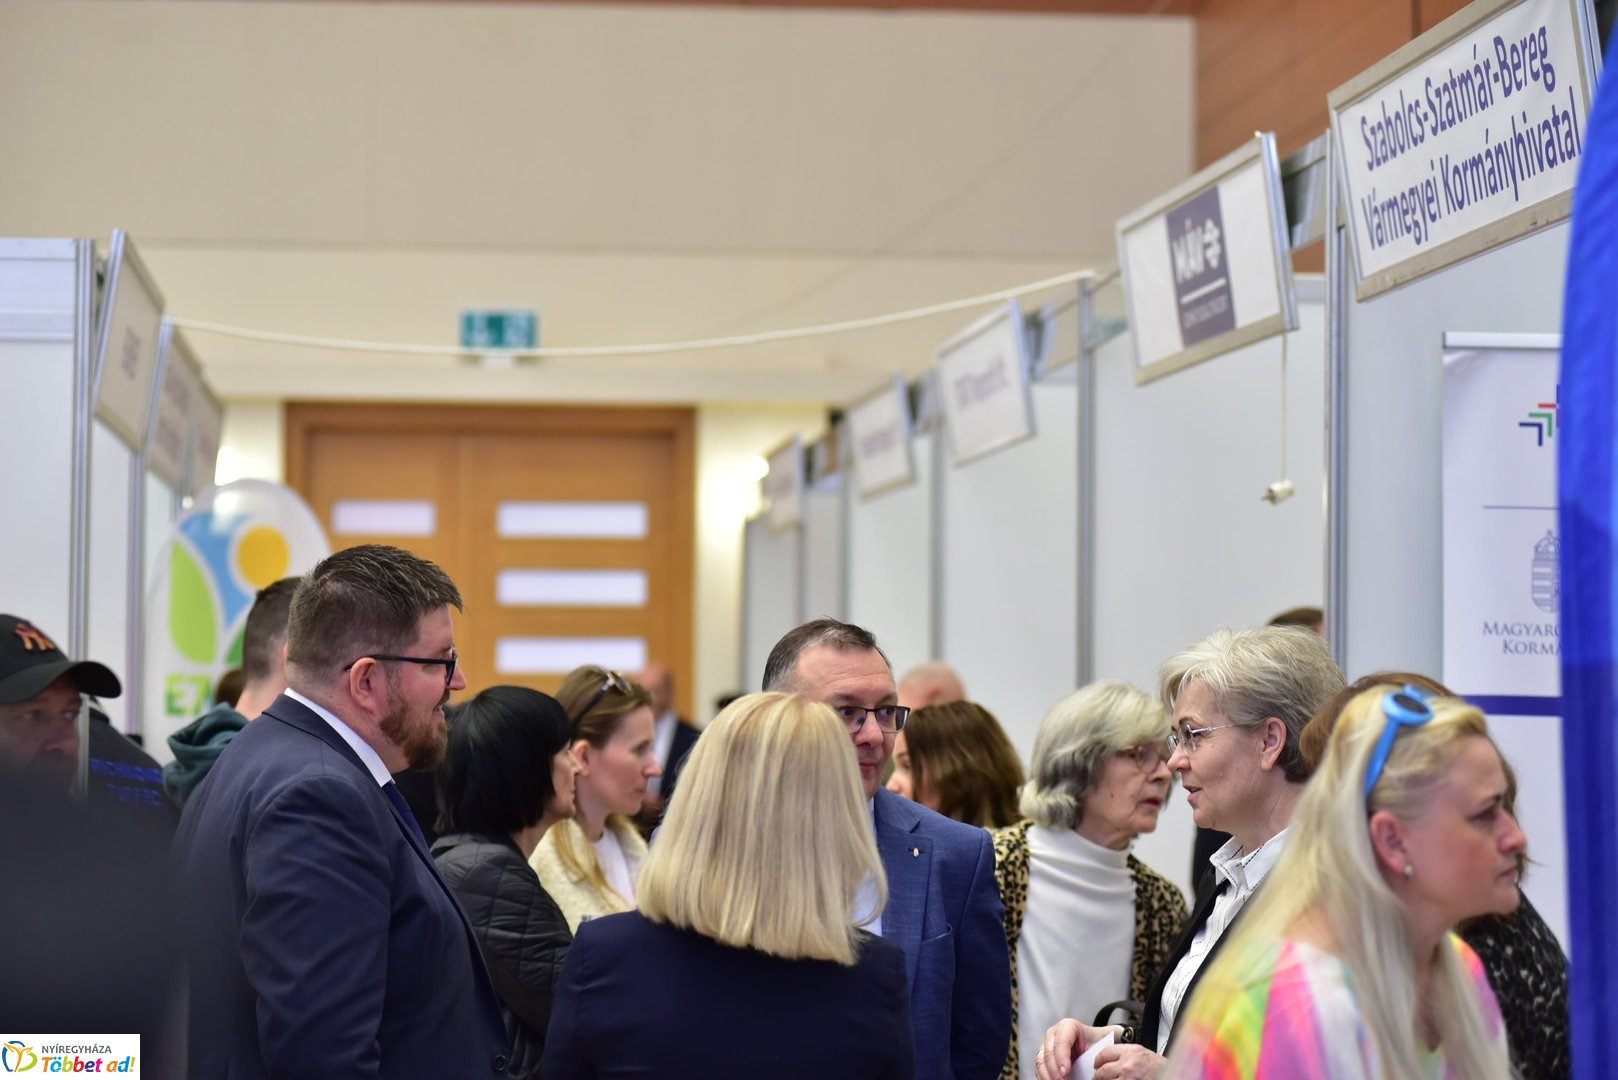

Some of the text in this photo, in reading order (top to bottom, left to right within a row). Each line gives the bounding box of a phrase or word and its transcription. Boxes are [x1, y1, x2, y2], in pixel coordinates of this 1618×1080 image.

[1360, 25, 1556, 172] Szabolcs-Szatmár-Bereg
[1361, 85, 1582, 250] Vármegyei Kormányhivatal
